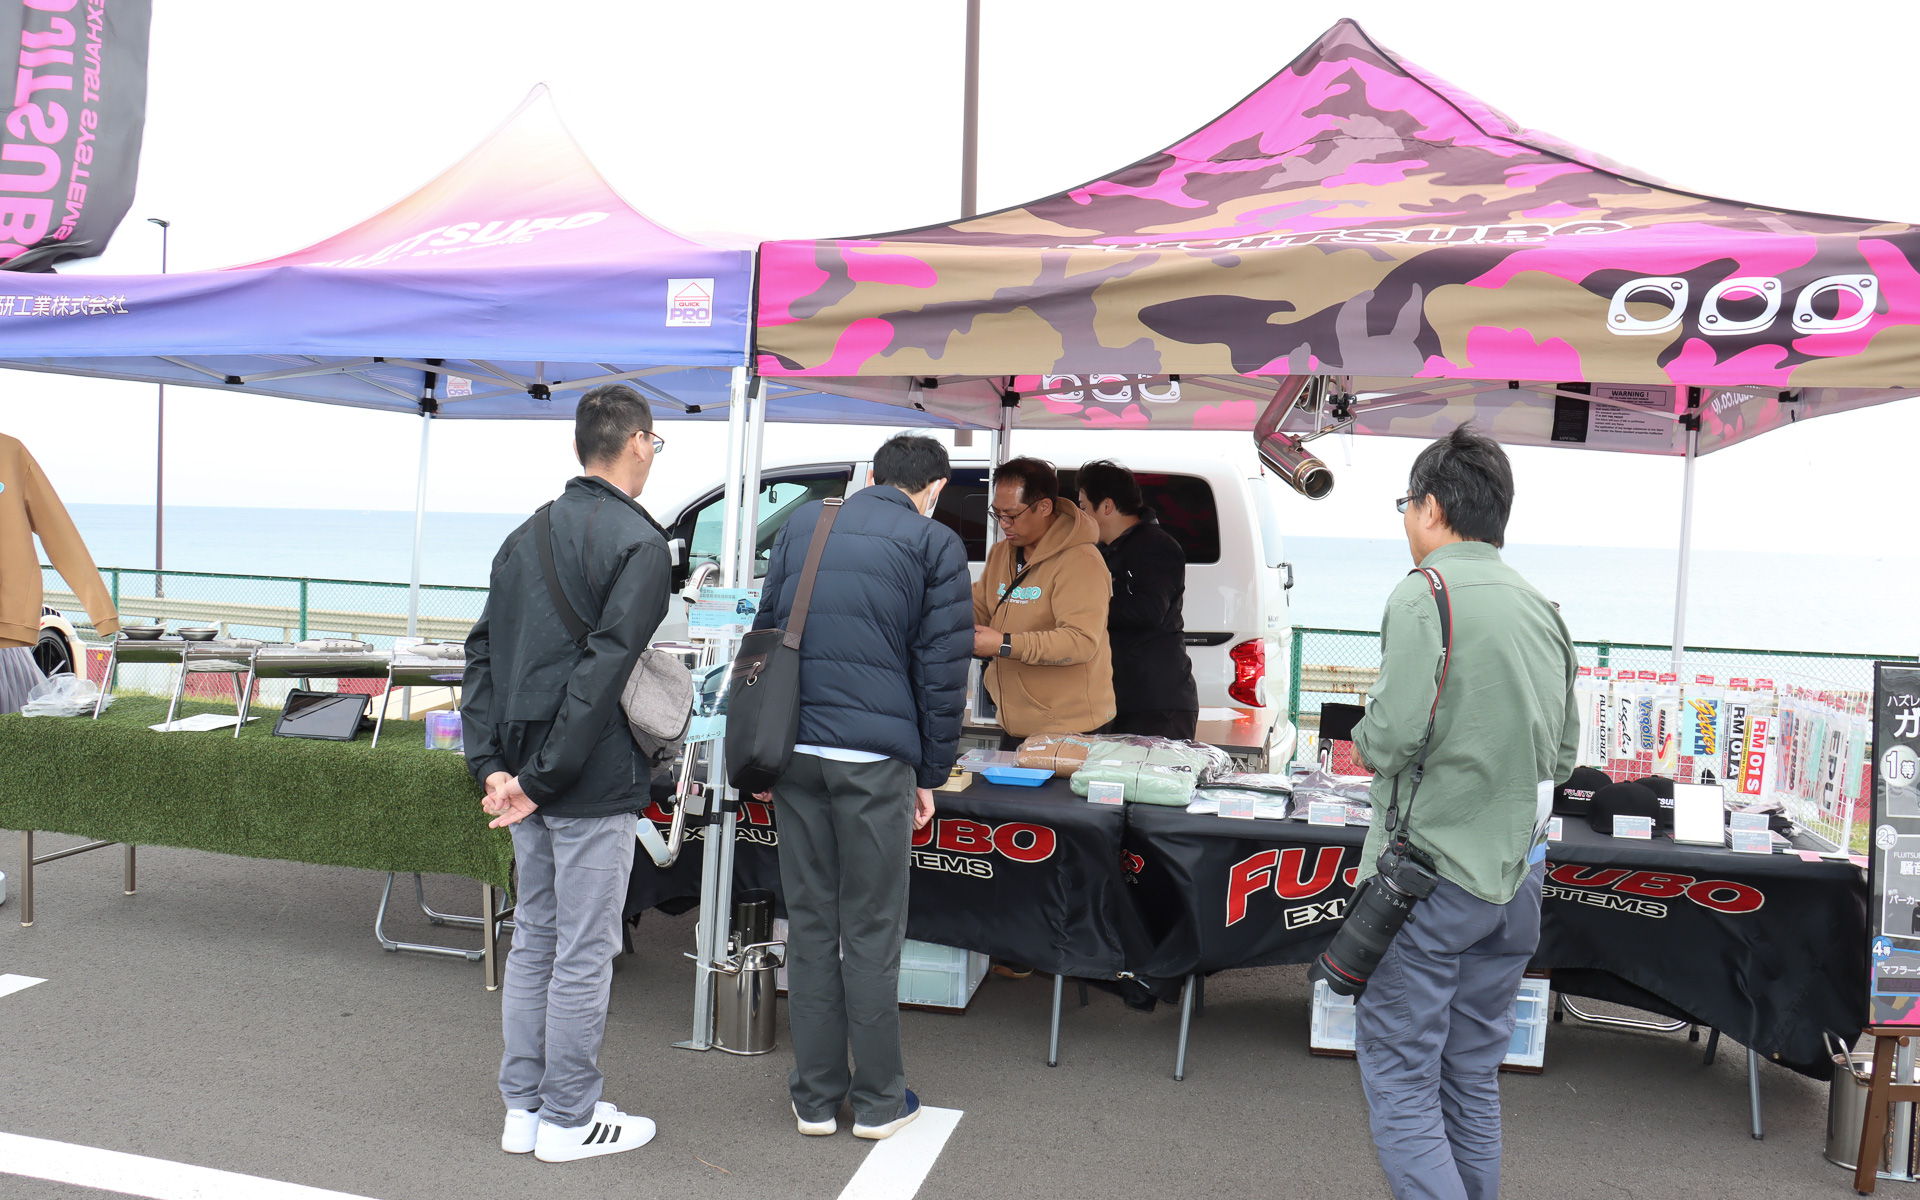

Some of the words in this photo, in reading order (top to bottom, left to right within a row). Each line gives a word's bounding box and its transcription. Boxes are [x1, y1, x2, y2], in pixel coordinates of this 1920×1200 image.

[670, 308, 709, 320] PRO
[1612, 390, 1645, 398] WARNING
[1599, 694, 1607, 764] AUTHORIZE
[1639, 697, 1654, 750] Wagolis
[1751, 720, 1767, 749] RM
